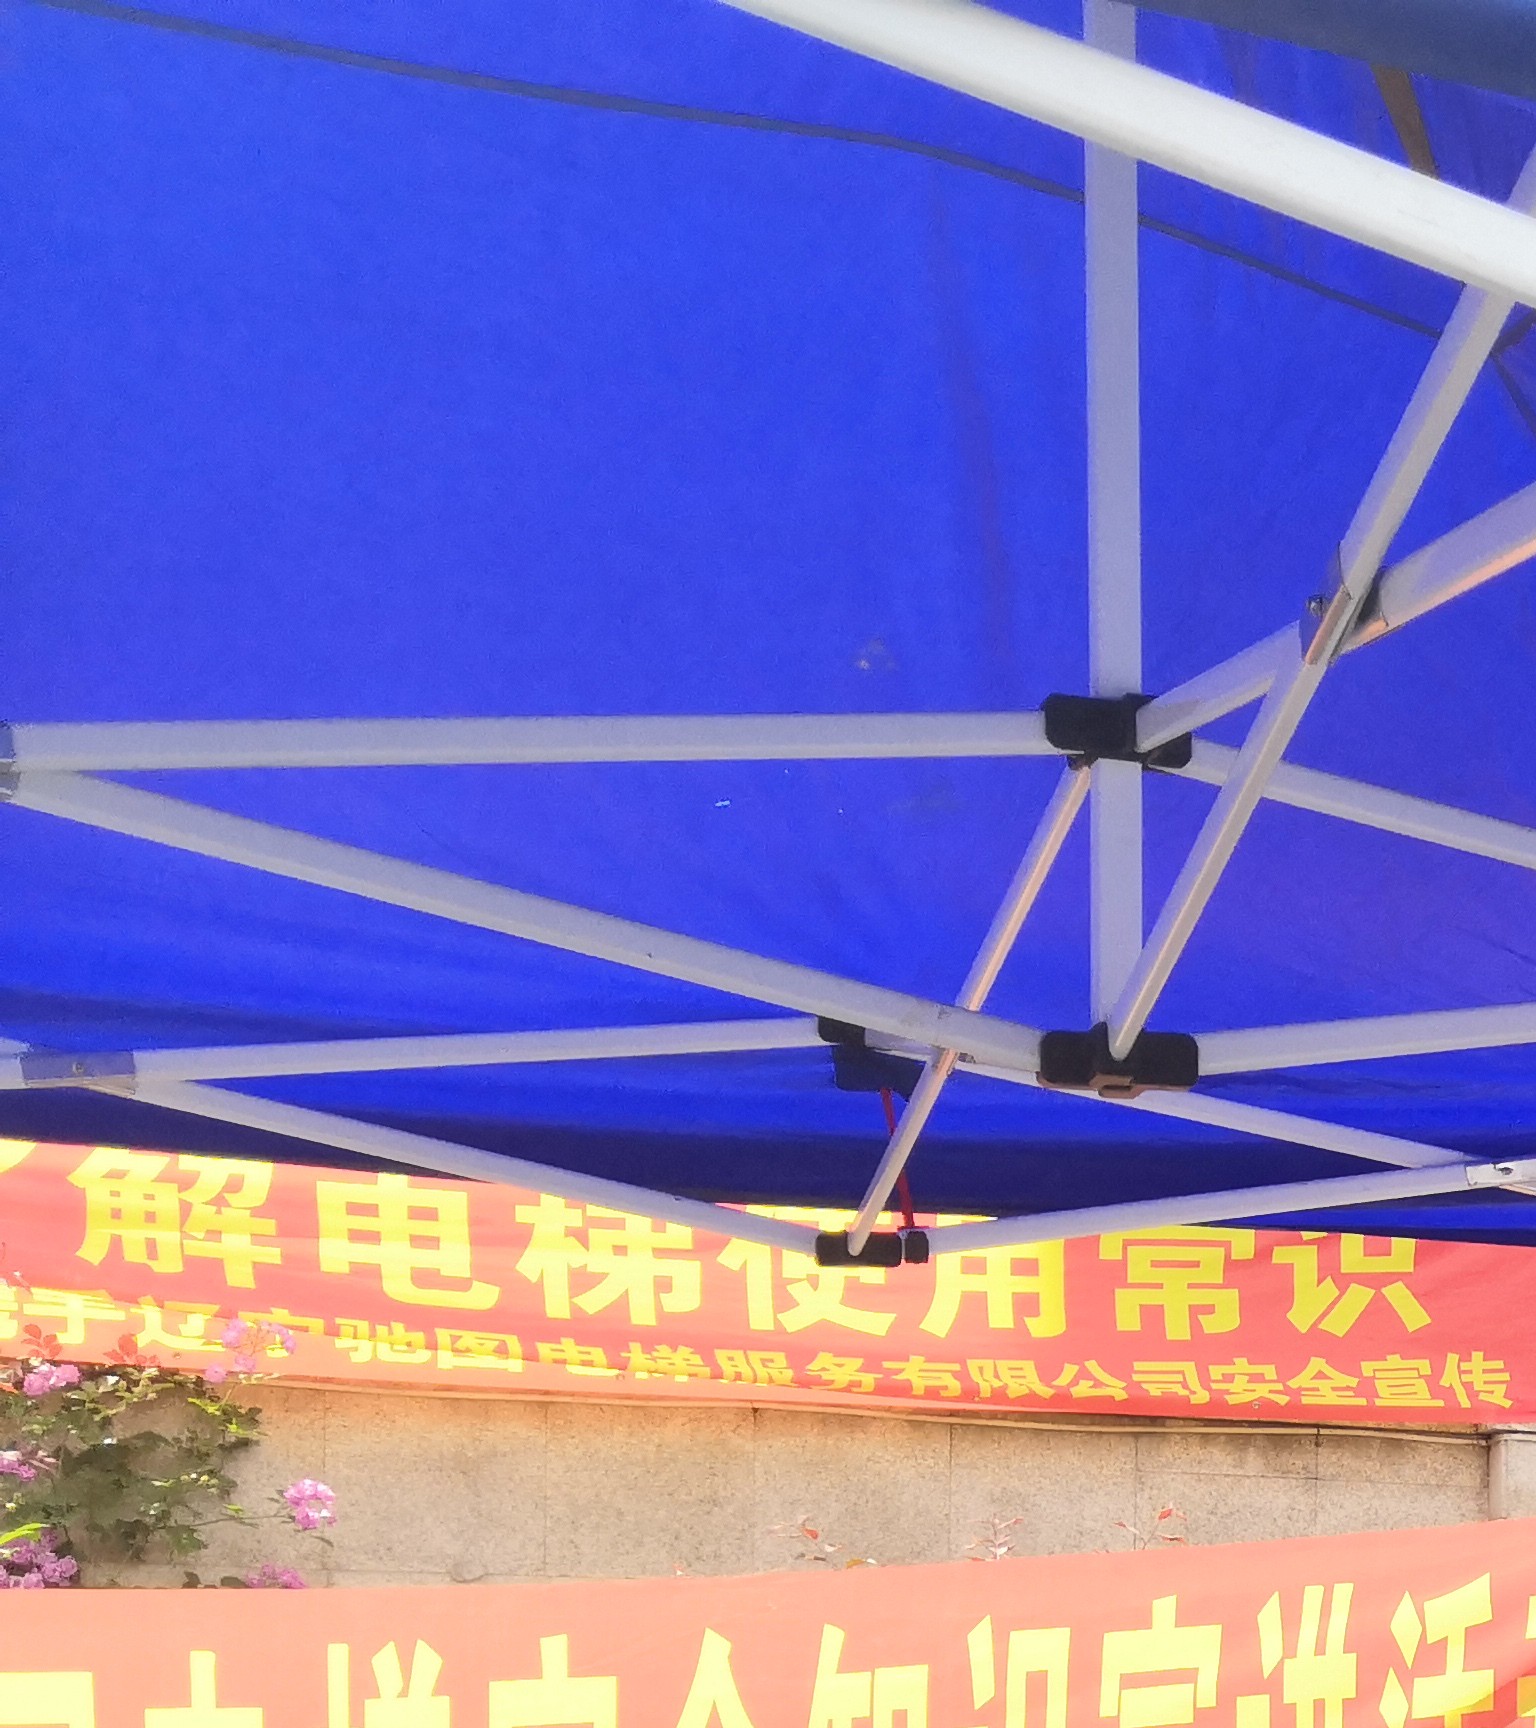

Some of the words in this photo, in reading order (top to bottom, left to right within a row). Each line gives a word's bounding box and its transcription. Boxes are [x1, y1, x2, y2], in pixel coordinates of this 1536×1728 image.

[0, 1139, 1432, 1341] 解电梯使用常识
[0, 1286, 1514, 1409] 手辽宁驰图电梯服务有限公司安全宣传
